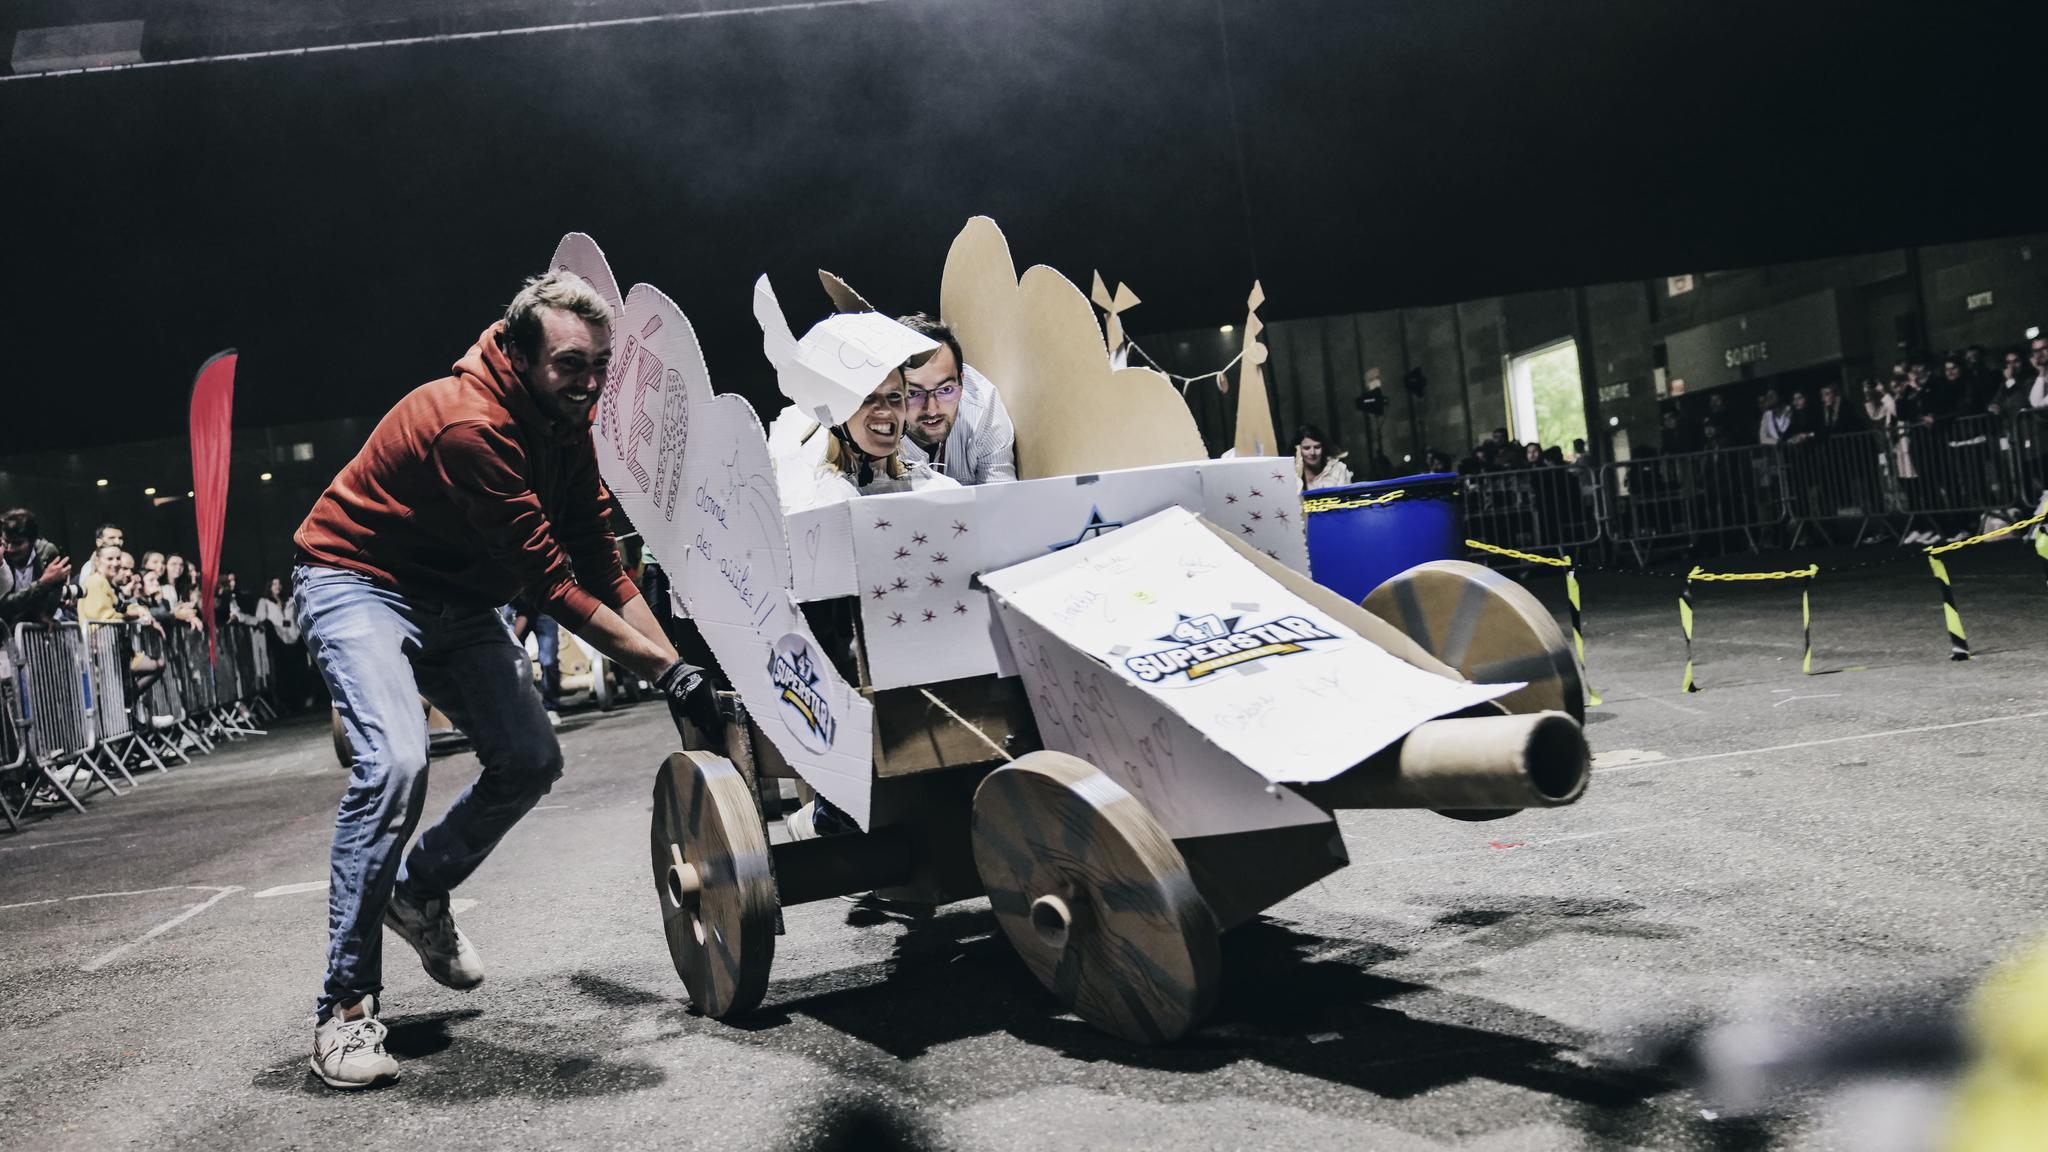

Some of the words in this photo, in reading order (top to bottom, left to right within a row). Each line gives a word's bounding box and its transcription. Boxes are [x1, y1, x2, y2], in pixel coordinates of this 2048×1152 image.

[1724, 340, 1769, 368] SORTIE
[695, 527, 713, 561] des
[1173, 613, 1230, 642] 47
[1126, 616, 1332, 682] SUPERSTAR
[797, 654, 814, 684] 47
[773, 656, 830, 738] SUPERSTAR
